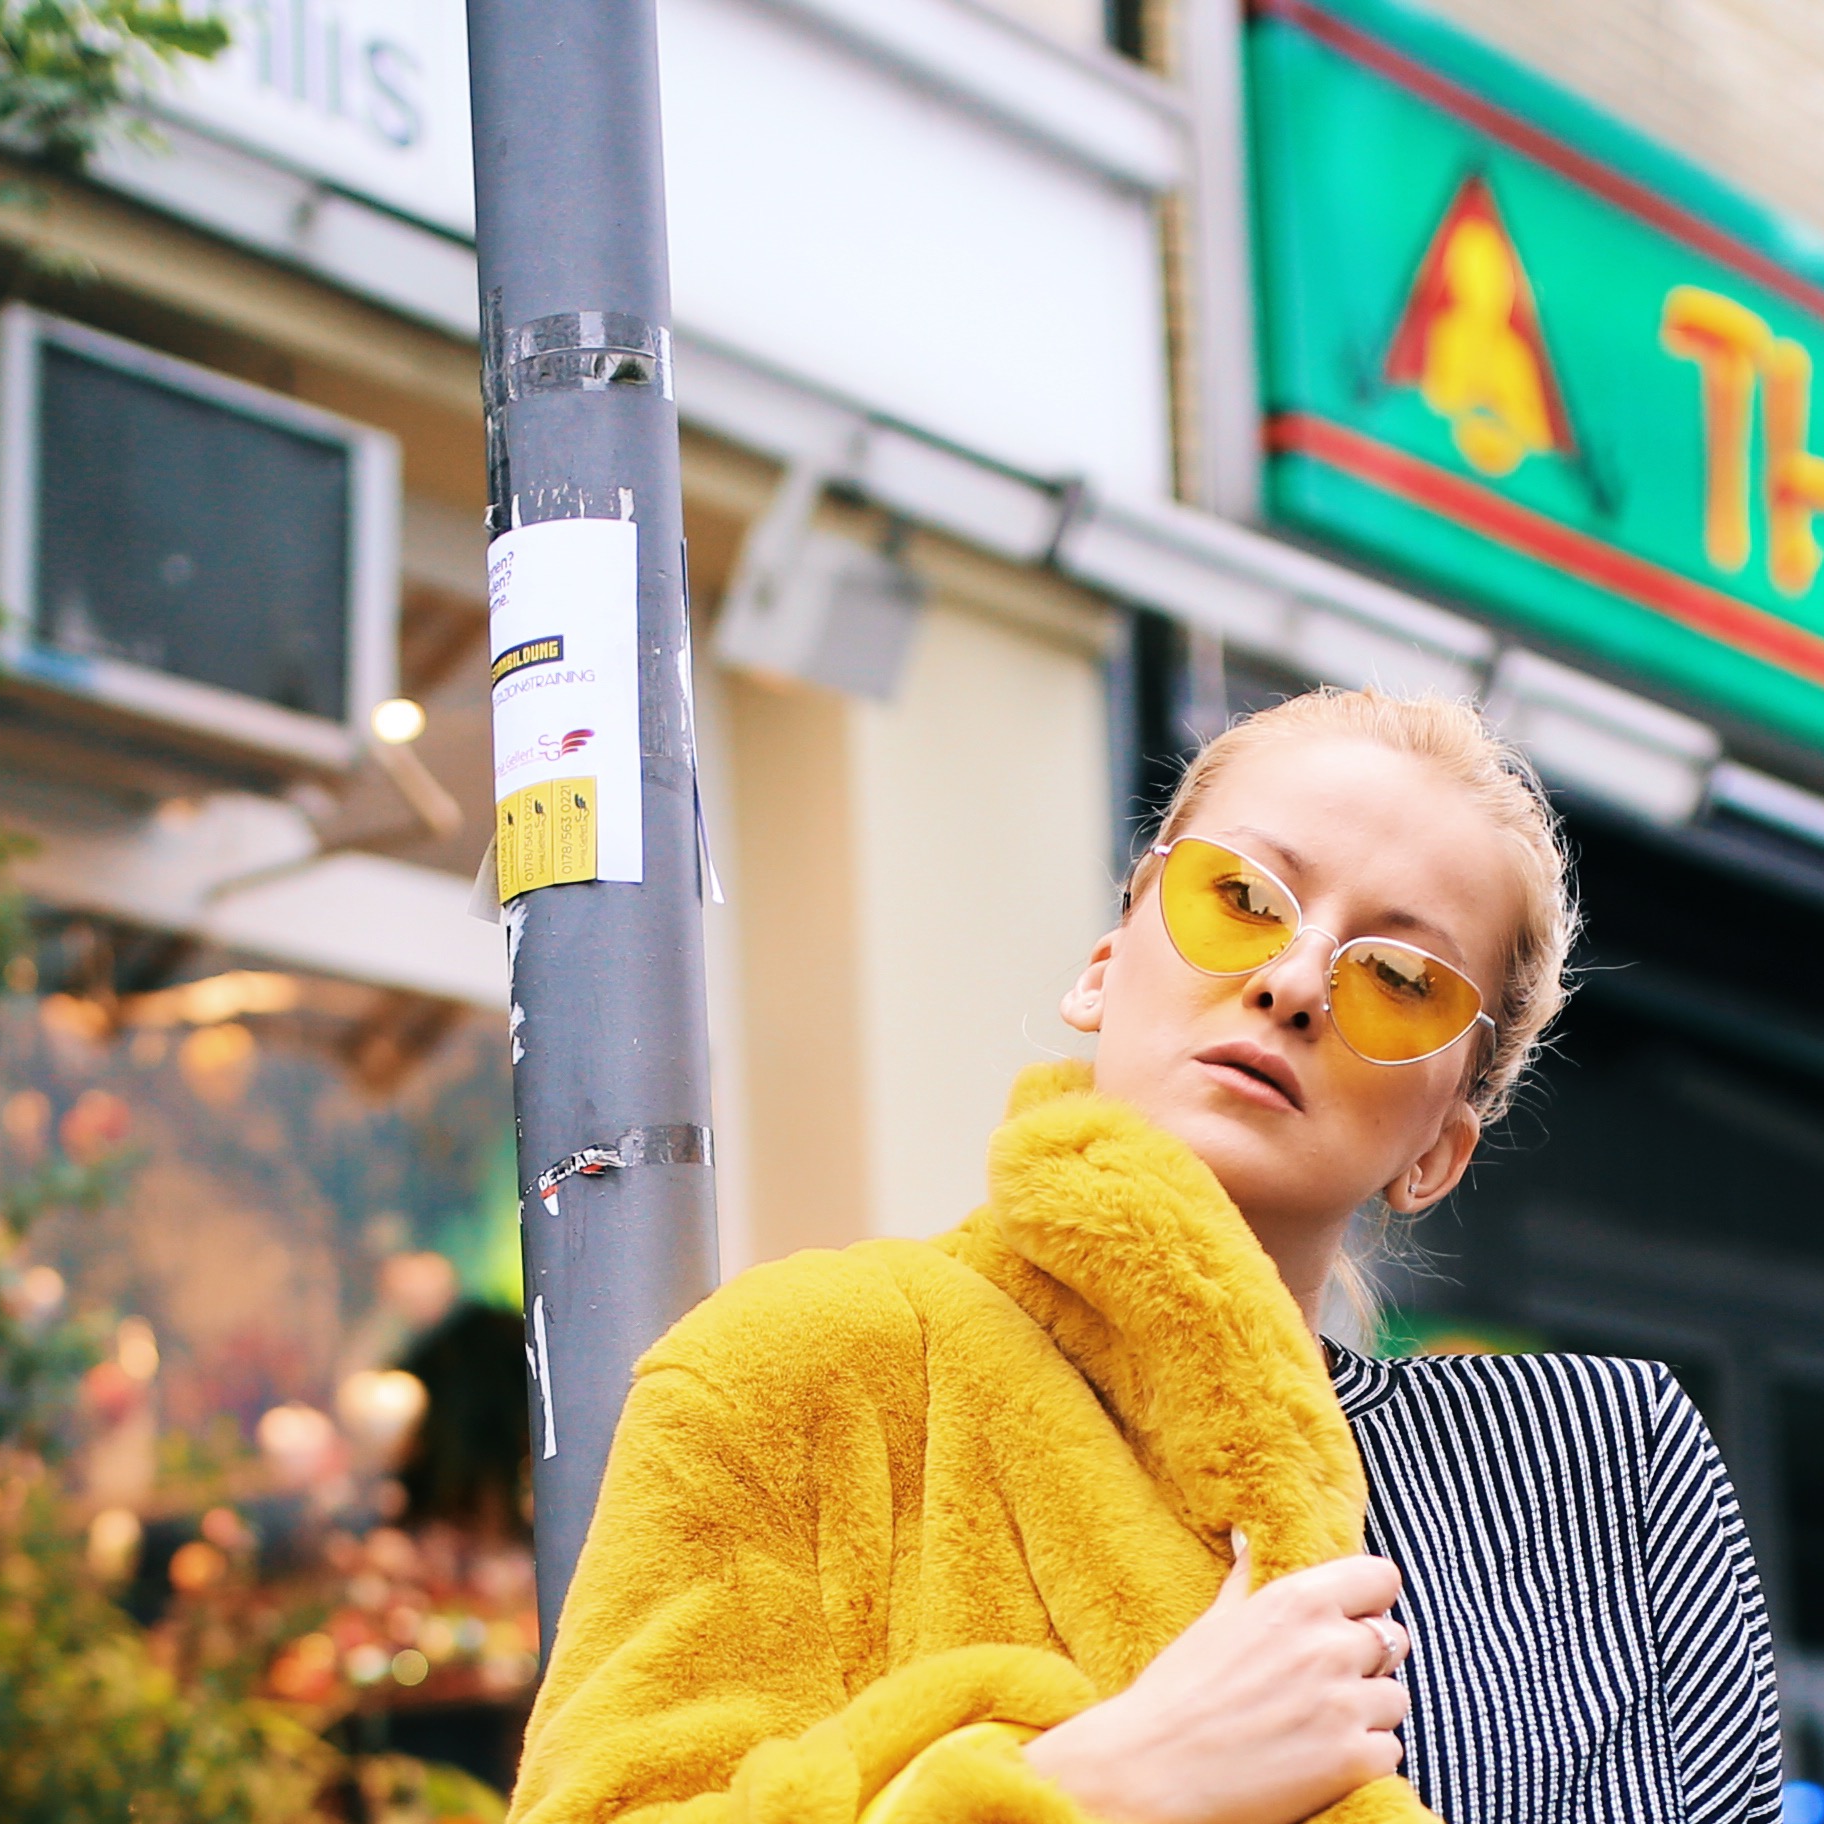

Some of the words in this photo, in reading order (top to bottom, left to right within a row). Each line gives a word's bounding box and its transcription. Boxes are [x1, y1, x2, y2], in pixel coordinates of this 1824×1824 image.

[524, 791, 533, 821] 0221
[560, 784, 572, 813] 0221
[560, 816, 573, 875] 0178/563
